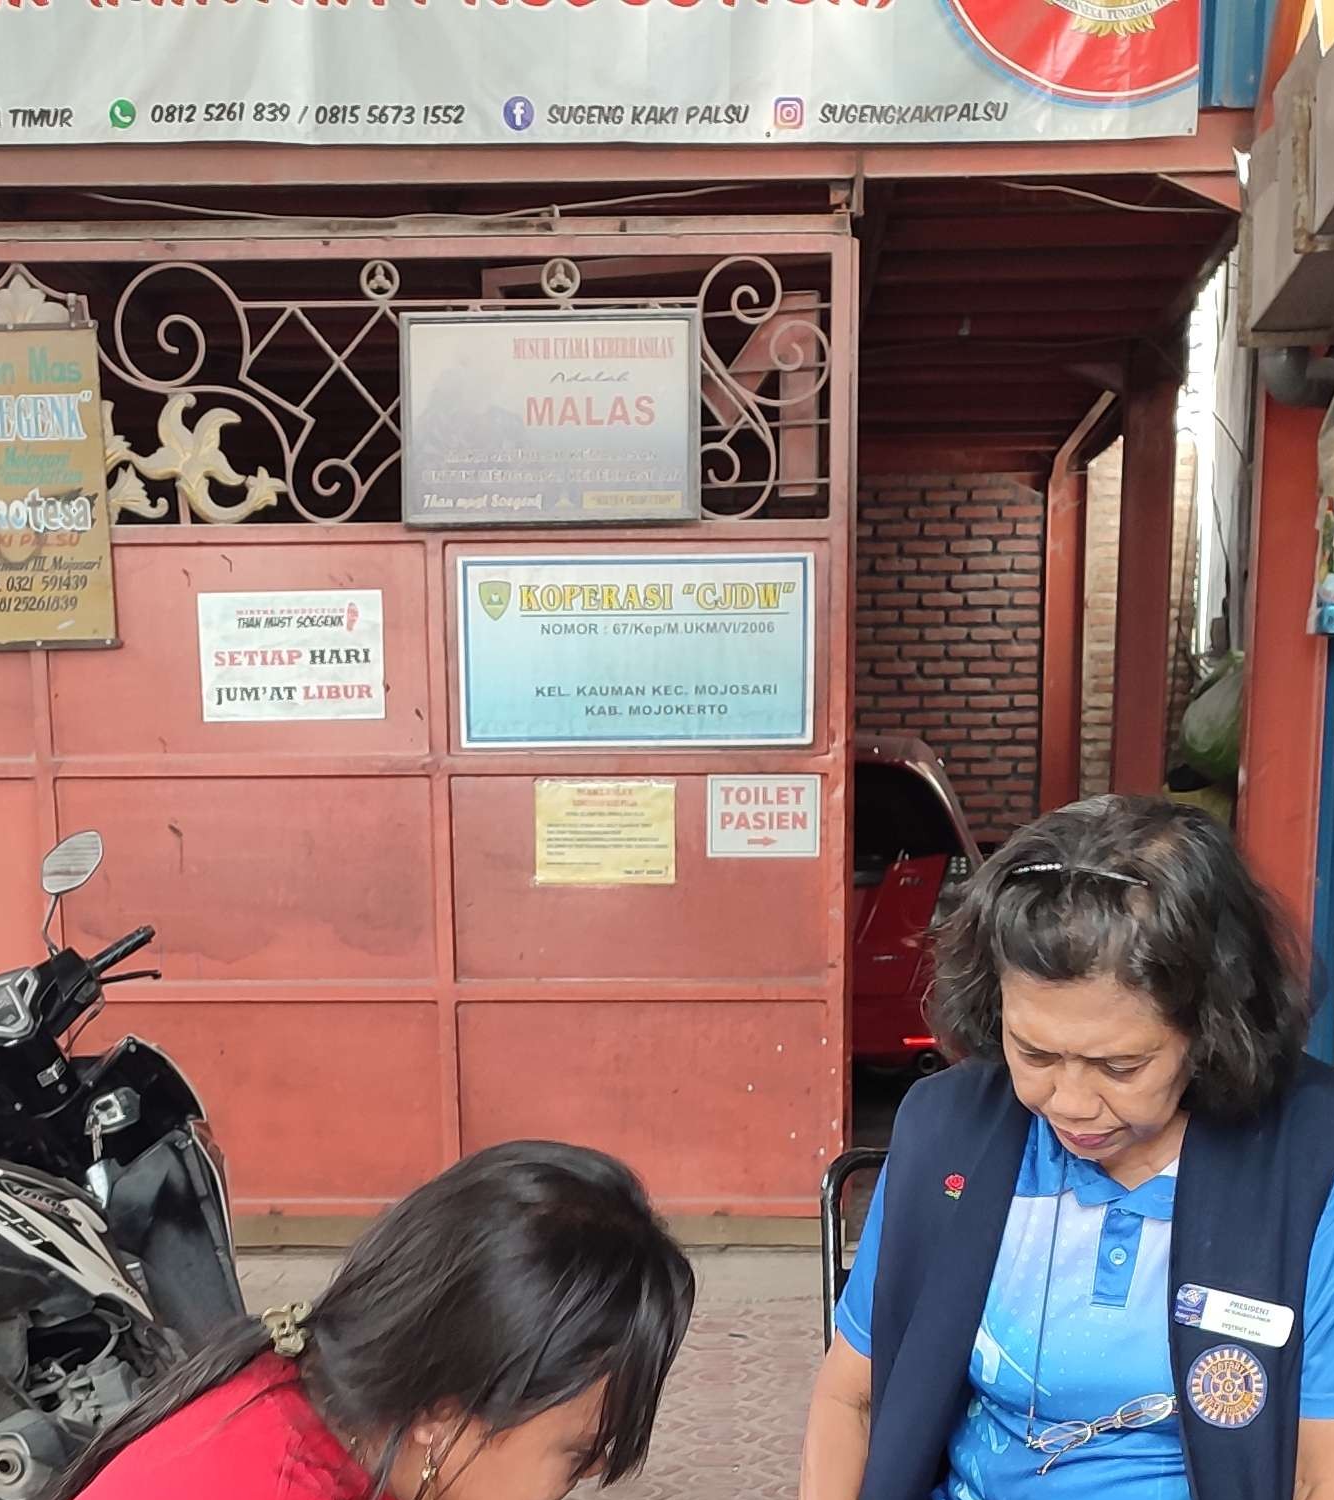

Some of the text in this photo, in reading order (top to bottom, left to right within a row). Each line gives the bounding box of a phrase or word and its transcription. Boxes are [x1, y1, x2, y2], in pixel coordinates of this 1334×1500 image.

[8, 108, 74, 128] TIMUR
[150, 104, 196, 123] 0812
[202, 102, 245, 123] 5261
[252, 104, 291, 123] 839
[314, 104, 360, 125] 0815
[365, 104, 415, 124] 5673
[422, 104, 465, 124] 1552
[547, 104, 750, 125] SUGENG KAKI PALSU
[819, 102, 1009, 124] SUGENGKAKIPALSU
[553, 337, 590, 359] UTAMA
[28, 346, 82, 384] Mas
[525, 395, 657, 428] MALAS
[20, 531, 81, 547] PALSU
[6, 576, 33, 593] 0321
[42, 574, 88, 593] 591439
[519, 584, 674, 612] KOPERASI
[237, 617, 262, 629] THAN
[540, 623, 599, 636] NOMOR
[214, 648, 372, 667] SETIAP HARI
[303, 684, 374, 701] LIBUR
[575, 685, 646, 697] KAUMAN
[652, 684, 690, 698] KEC.
[693, 683, 779, 697] MOJOSARI
[585, 704, 729, 717] KAB. MOJOKERTO
[720, 786, 806, 806] TOILET
[720, 811, 808, 831] PASIEN
[1229, 1300, 1271, 1316] PRESIDENT
